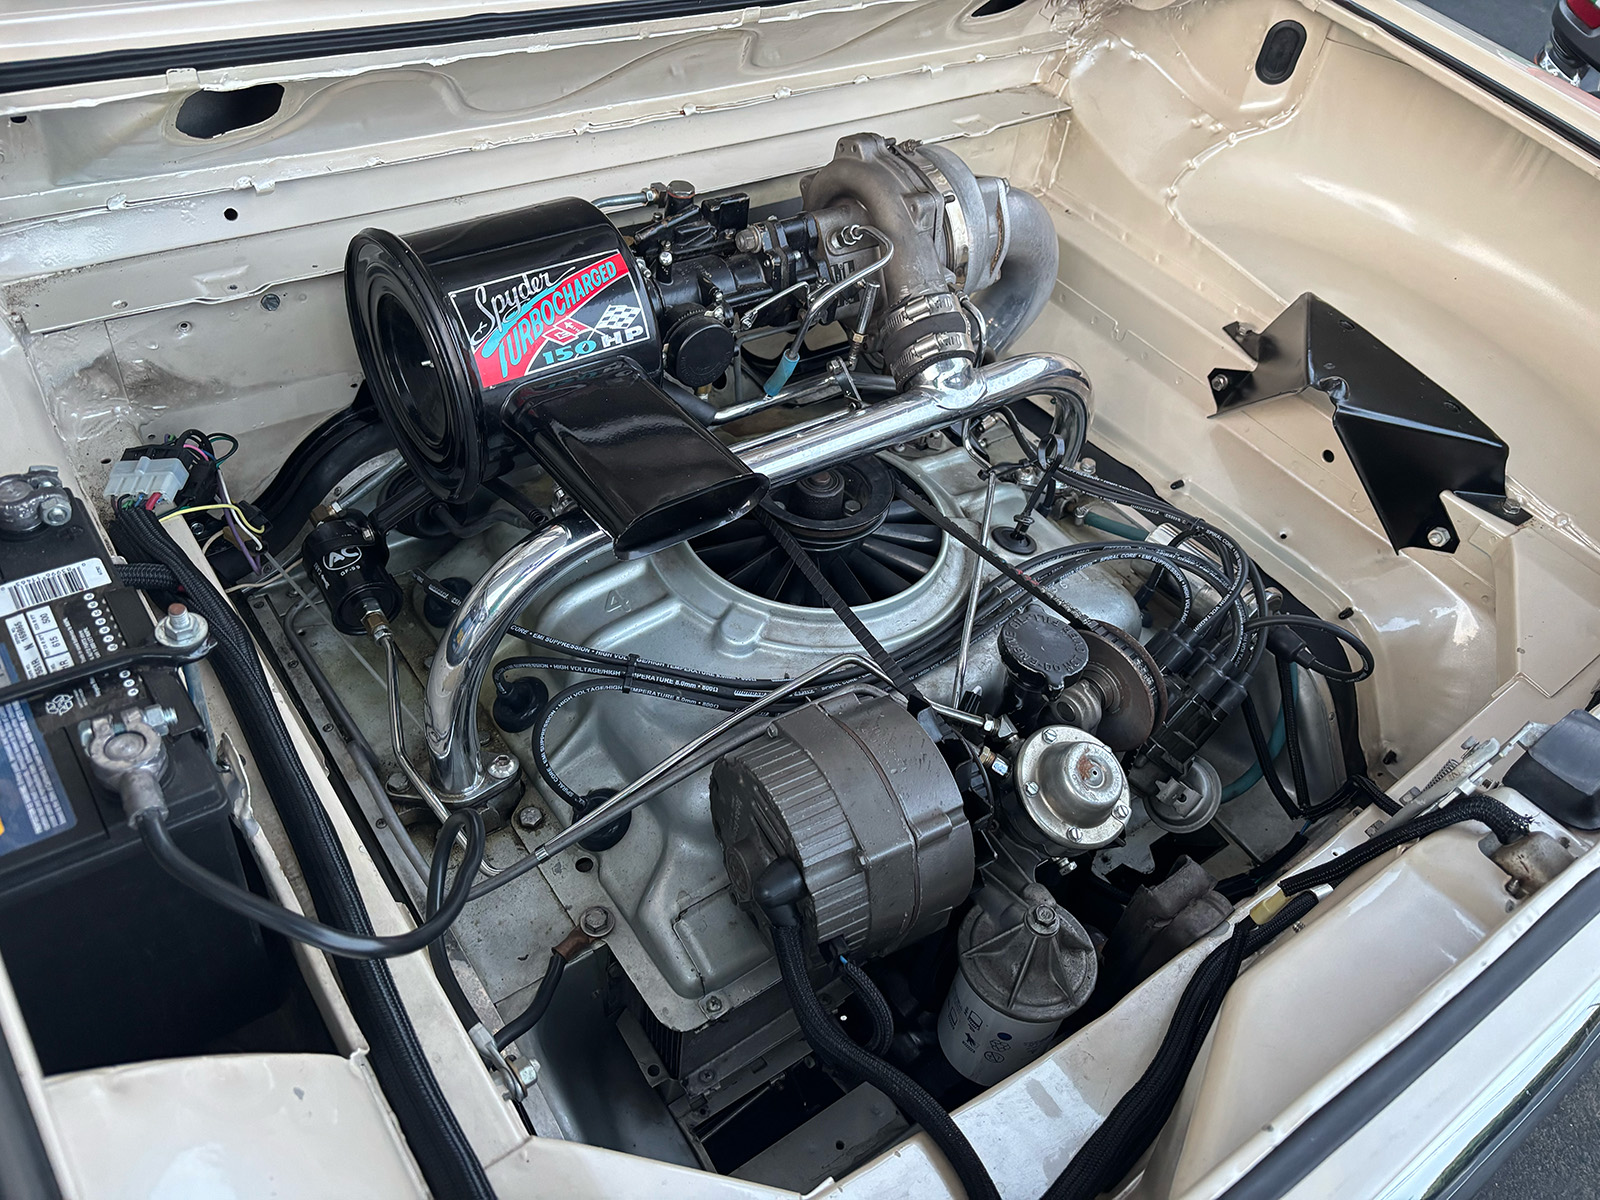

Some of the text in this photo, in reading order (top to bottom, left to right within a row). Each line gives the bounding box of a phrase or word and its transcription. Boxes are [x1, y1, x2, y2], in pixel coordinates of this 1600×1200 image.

[470, 266, 576, 345] Spyder
[482, 261, 617, 378] TURBOCHARGED
[543, 325, 645, 365] 150 HP
[1205, 528, 1222, 541] SPIRAL
[1222, 538, 1234, 550] CORE
[329, 548, 359, 568] AC
[1099, 554, 1119, 562] SPIRAL
[1152, 556, 1183, 582] SUPPRESSION
[1182, 584, 1190, 599] HIGH
[39, 612, 50, 624] 500
[49, 635, 60, 648] 615
[510, 624, 529, 635] CORE
[532, 633, 544, 641] EMI
[544, 636, 590, 654] SUPPRESSION
[595, 649, 612, 658] HIGH
[614, 653, 665, 667] VOLGE/HIGH
[30, 657, 44, 677] 551R
[570, 665, 621, 676] VOLTAGE/HIGH
[675, 680, 696, 689] 8.0mm
[558, 695, 573, 707] HIGH
[573, 685, 623, 697] VOLTAGE/HIGH
[546, 767, 559, 783] CORE
[557, 781, 574, 798] SPIRAL
